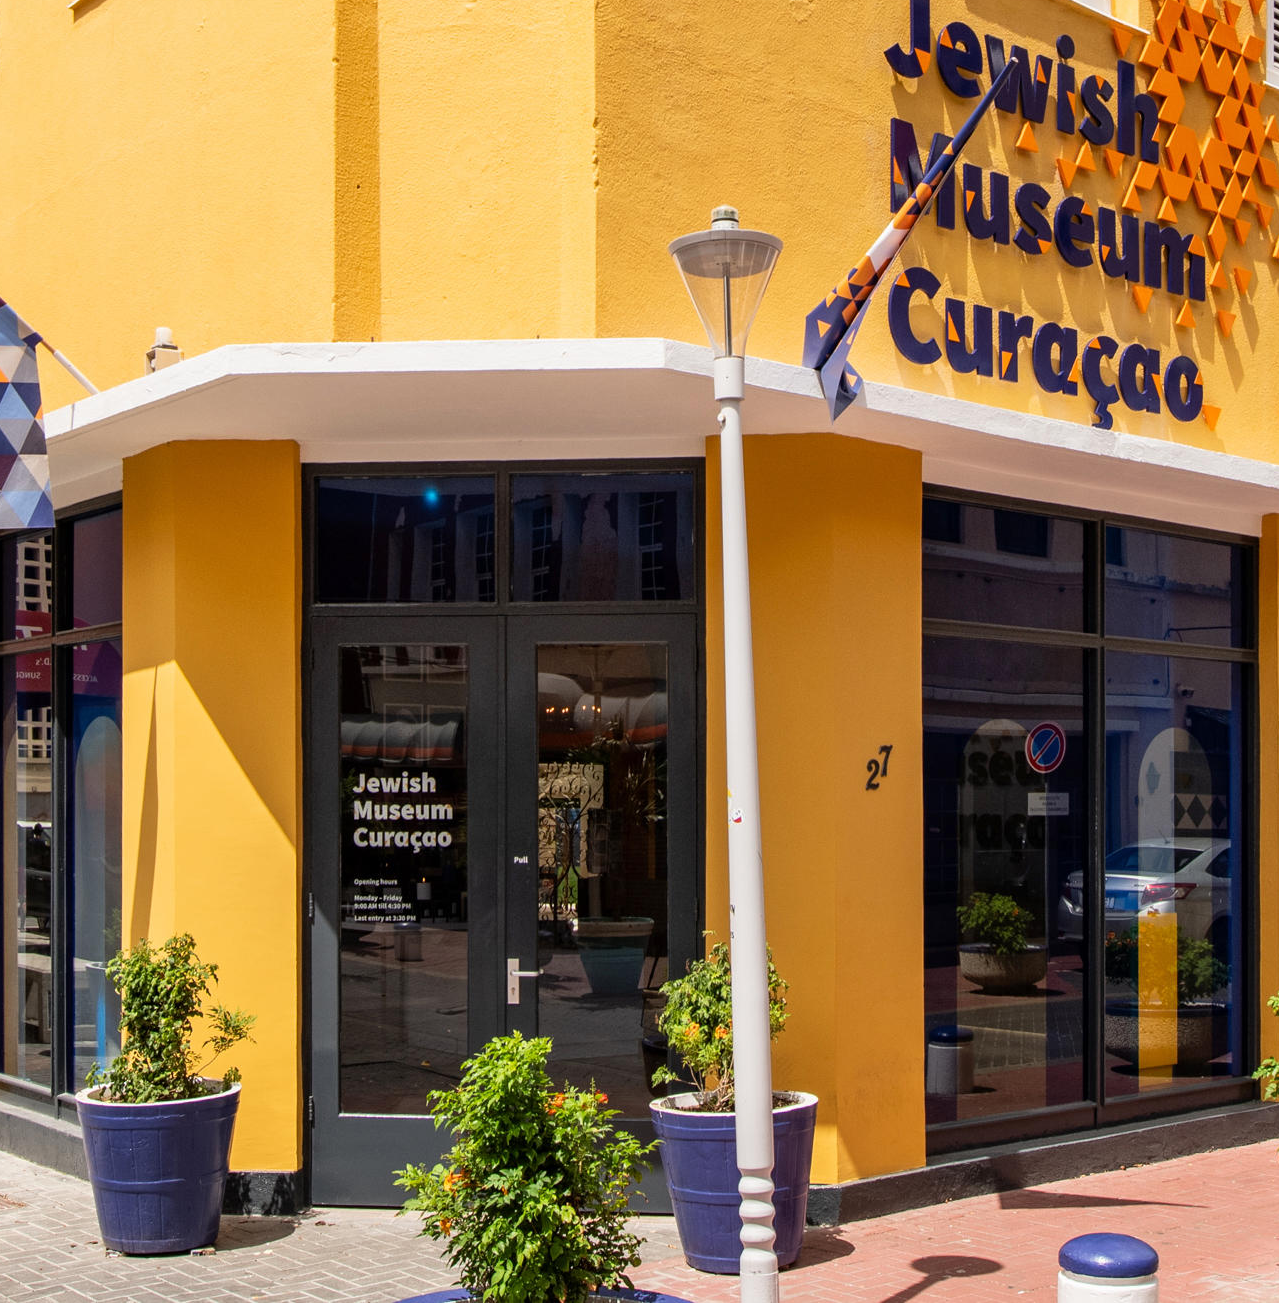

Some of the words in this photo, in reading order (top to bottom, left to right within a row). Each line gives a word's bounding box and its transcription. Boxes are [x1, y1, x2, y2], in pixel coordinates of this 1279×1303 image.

[890, 117, 1205, 301] Museum
[888, 267, 1204, 430] Curaçao
[865, 744, 893, 790] 27
[352, 771, 436, 793] Jewish
[353, 800, 453, 821] Museum
[353, 827, 452, 854] Curaçao
[514, 856, 528, 864] Pull
[354, 878, 379, 886] Opening
